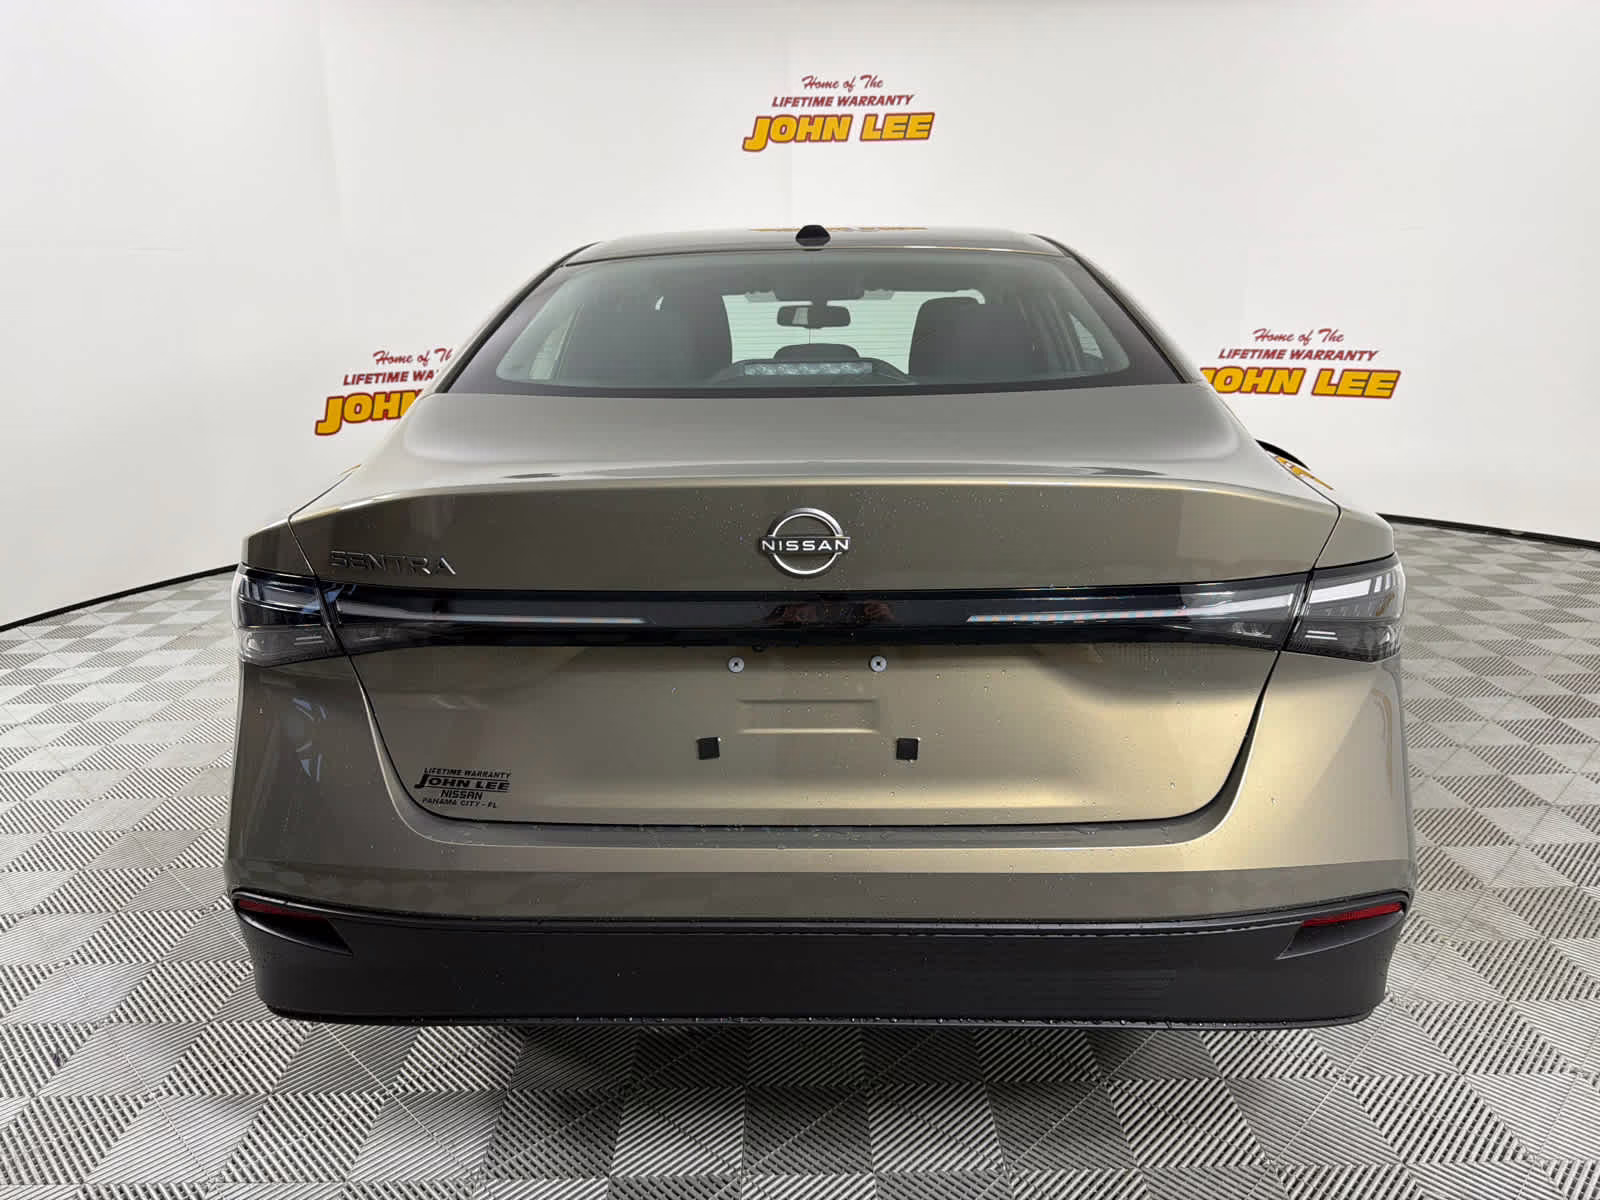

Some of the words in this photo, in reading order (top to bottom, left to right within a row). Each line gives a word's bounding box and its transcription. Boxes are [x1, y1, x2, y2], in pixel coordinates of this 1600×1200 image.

[801, 75, 839, 89] Home
[843, 76, 856, 92] of
[860, 74, 883, 89] The
[771, 96, 834, 107] LIFETIME
[837, 94, 914, 107] WARRANTY
[742, 114, 853, 152] JOHN
[860, 112, 935, 141] LEE
[1252, 328, 1294, 343] Home
[1298, 330, 1314, 345] of
[1318, 328, 1344, 343] The
[373, 350, 413, 365] Home
[417, 350, 430, 366] of
[1218, 349, 1286, 360] LIFETIME
[1289, 349, 1379, 361] WARRANTY
[343, 371, 409, 386] LIFETIME
[1312, 368, 1401, 399] LEE
[762, 539, 849, 551] NISSAN
[330, 550, 456, 575] SENTRA
[424, 767, 462, 775] LIFETIME
[463, 770, 511, 779] WARRANTY
[414, 774, 470, 789] JOHN
[475, 781, 510, 790] LEE
[422, 797, 457, 806] PANAMA
[440, 790, 483, 800] NISSAN
